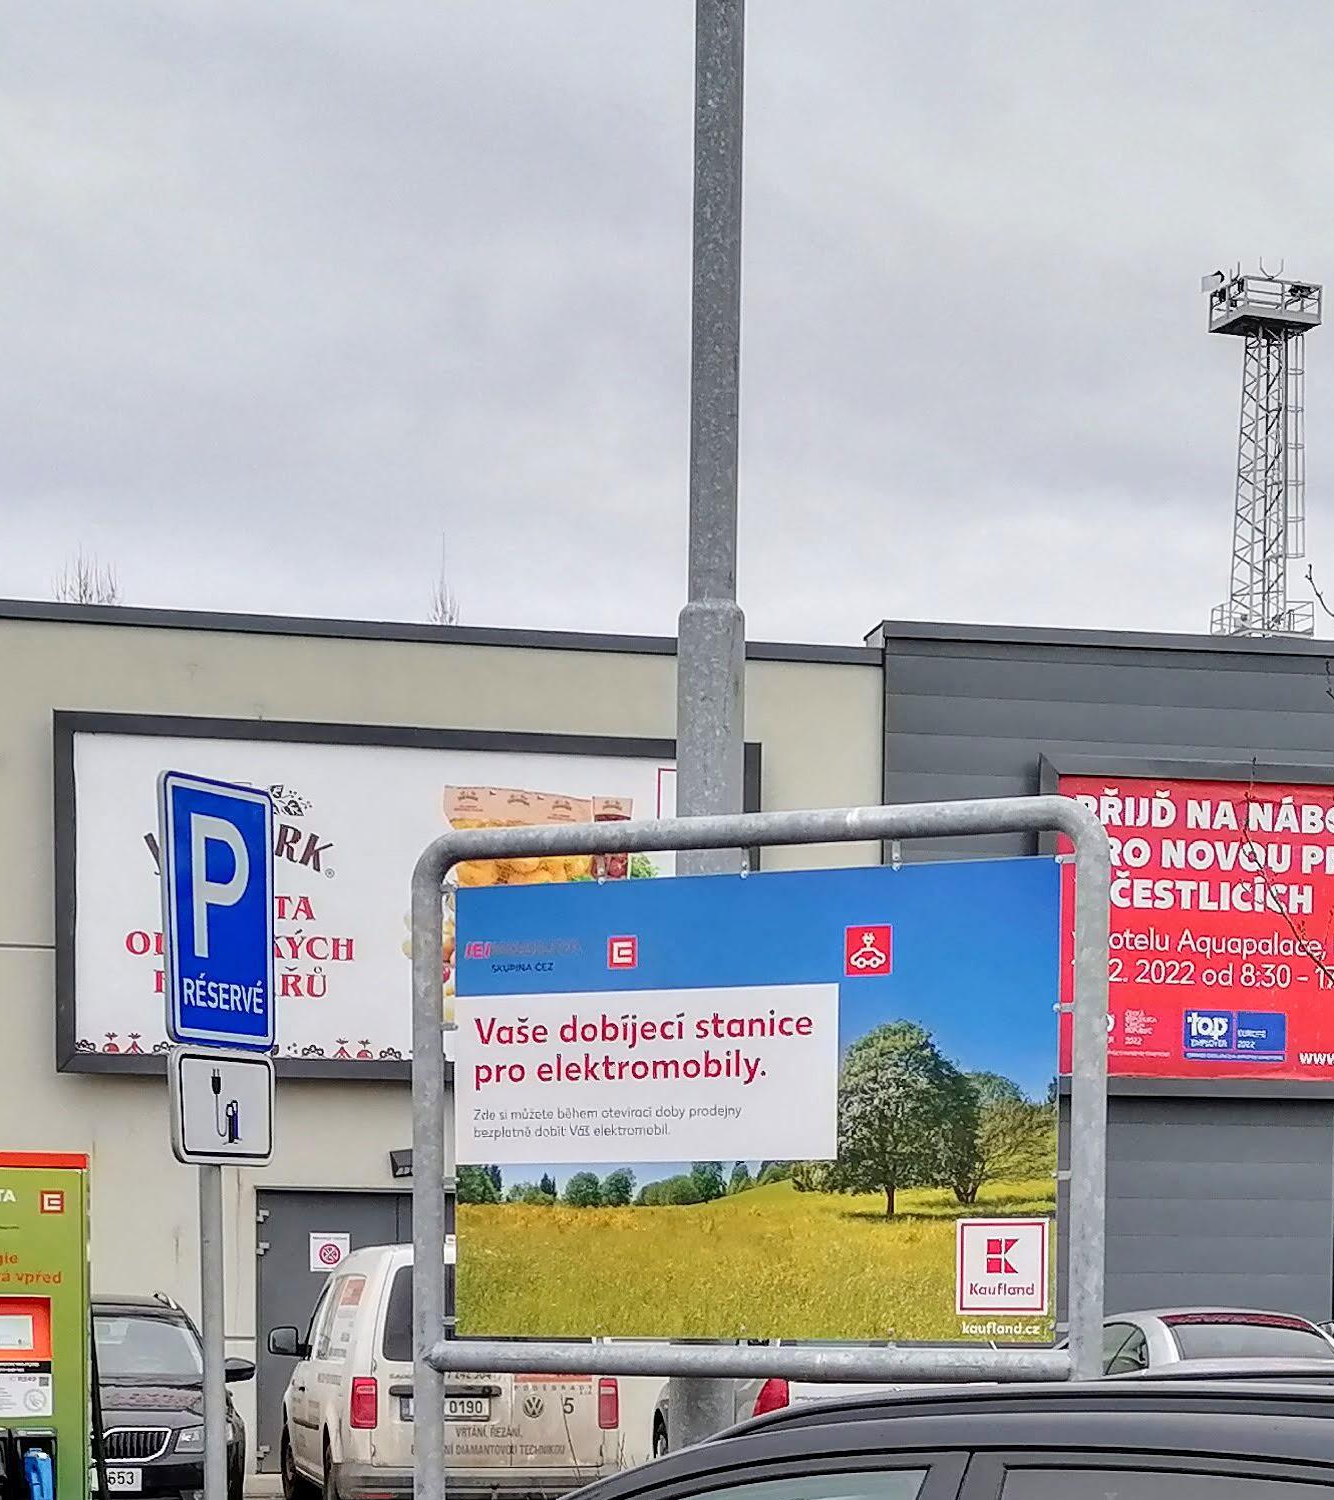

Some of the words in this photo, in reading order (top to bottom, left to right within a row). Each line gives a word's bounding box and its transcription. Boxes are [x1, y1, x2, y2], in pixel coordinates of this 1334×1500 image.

[1186, 799, 1239, 831] NA
[1108, 836, 1152, 868] RO
[1161, 839, 1291, 874] NOVOU
[190, 812, 250, 959] P
[1110, 870, 1313, 914] ČESTLICÍCH
[1108, 929, 1169, 952] otelu
[1177, 930, 1327, 961] Aquapalace,
[1134, 960, 1196, 985] 2022
[1200, 962, 1234, 987] od
[1240, 963, 1292, 989] 8:30
[182, 972, 264, 1014] RÉSERVÉ
[474, 1016, 548, 1045] Vaše
[559, 1012, 685, 1048] dobíjecí
[695, 1009, 814, 1040] stanice
[1187, 1012, 1229, 1040] top
[474, 1062, 526, 1091] pro
[536, 1049, 767, 1085] elektromobily.
[689, 1104, 742, 1120] prodejny
[16, 1271, 62, 1285] vpřed
[969, 1282, 1035, 1296] Kaufland
[961, 1321, 1041, 1335] kaufland.cz
[448, 1400, 483, 1414] 0190
